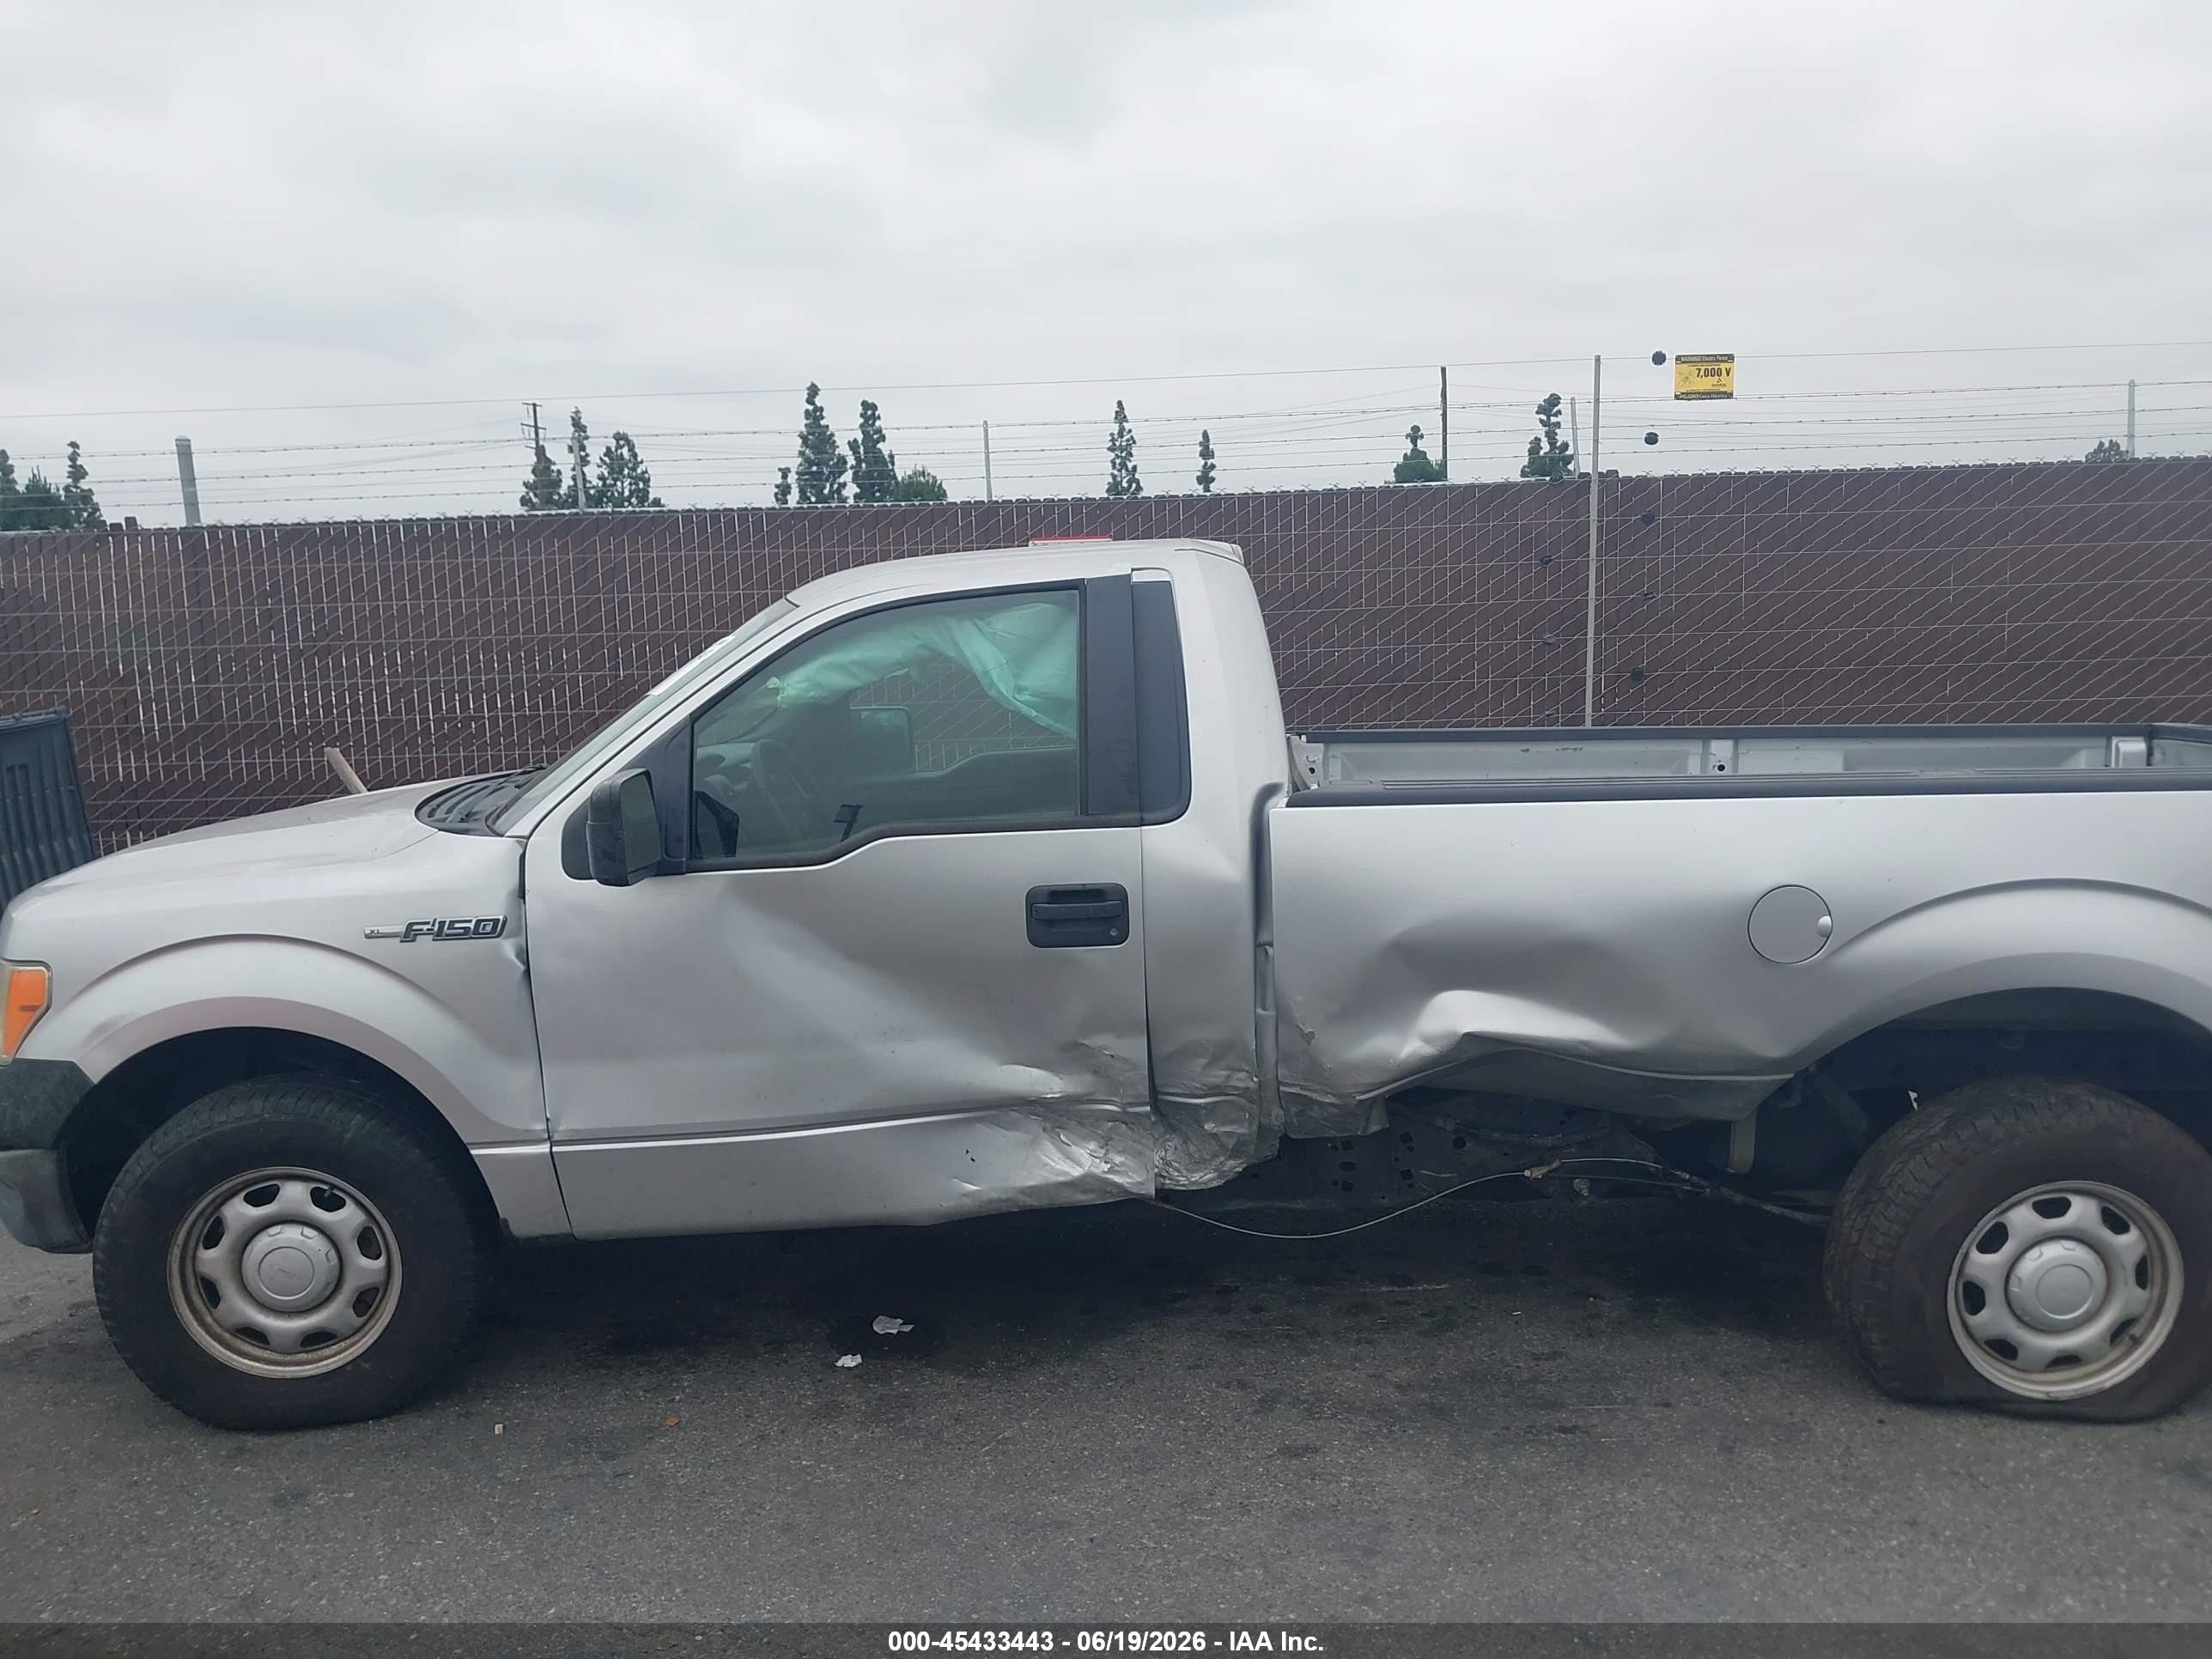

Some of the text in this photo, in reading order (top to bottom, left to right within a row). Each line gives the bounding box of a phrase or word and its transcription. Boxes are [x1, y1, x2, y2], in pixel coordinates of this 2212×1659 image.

[1696, 367, 1731, 379] 7,000 V
[400, 915, 507, 943] F-150
